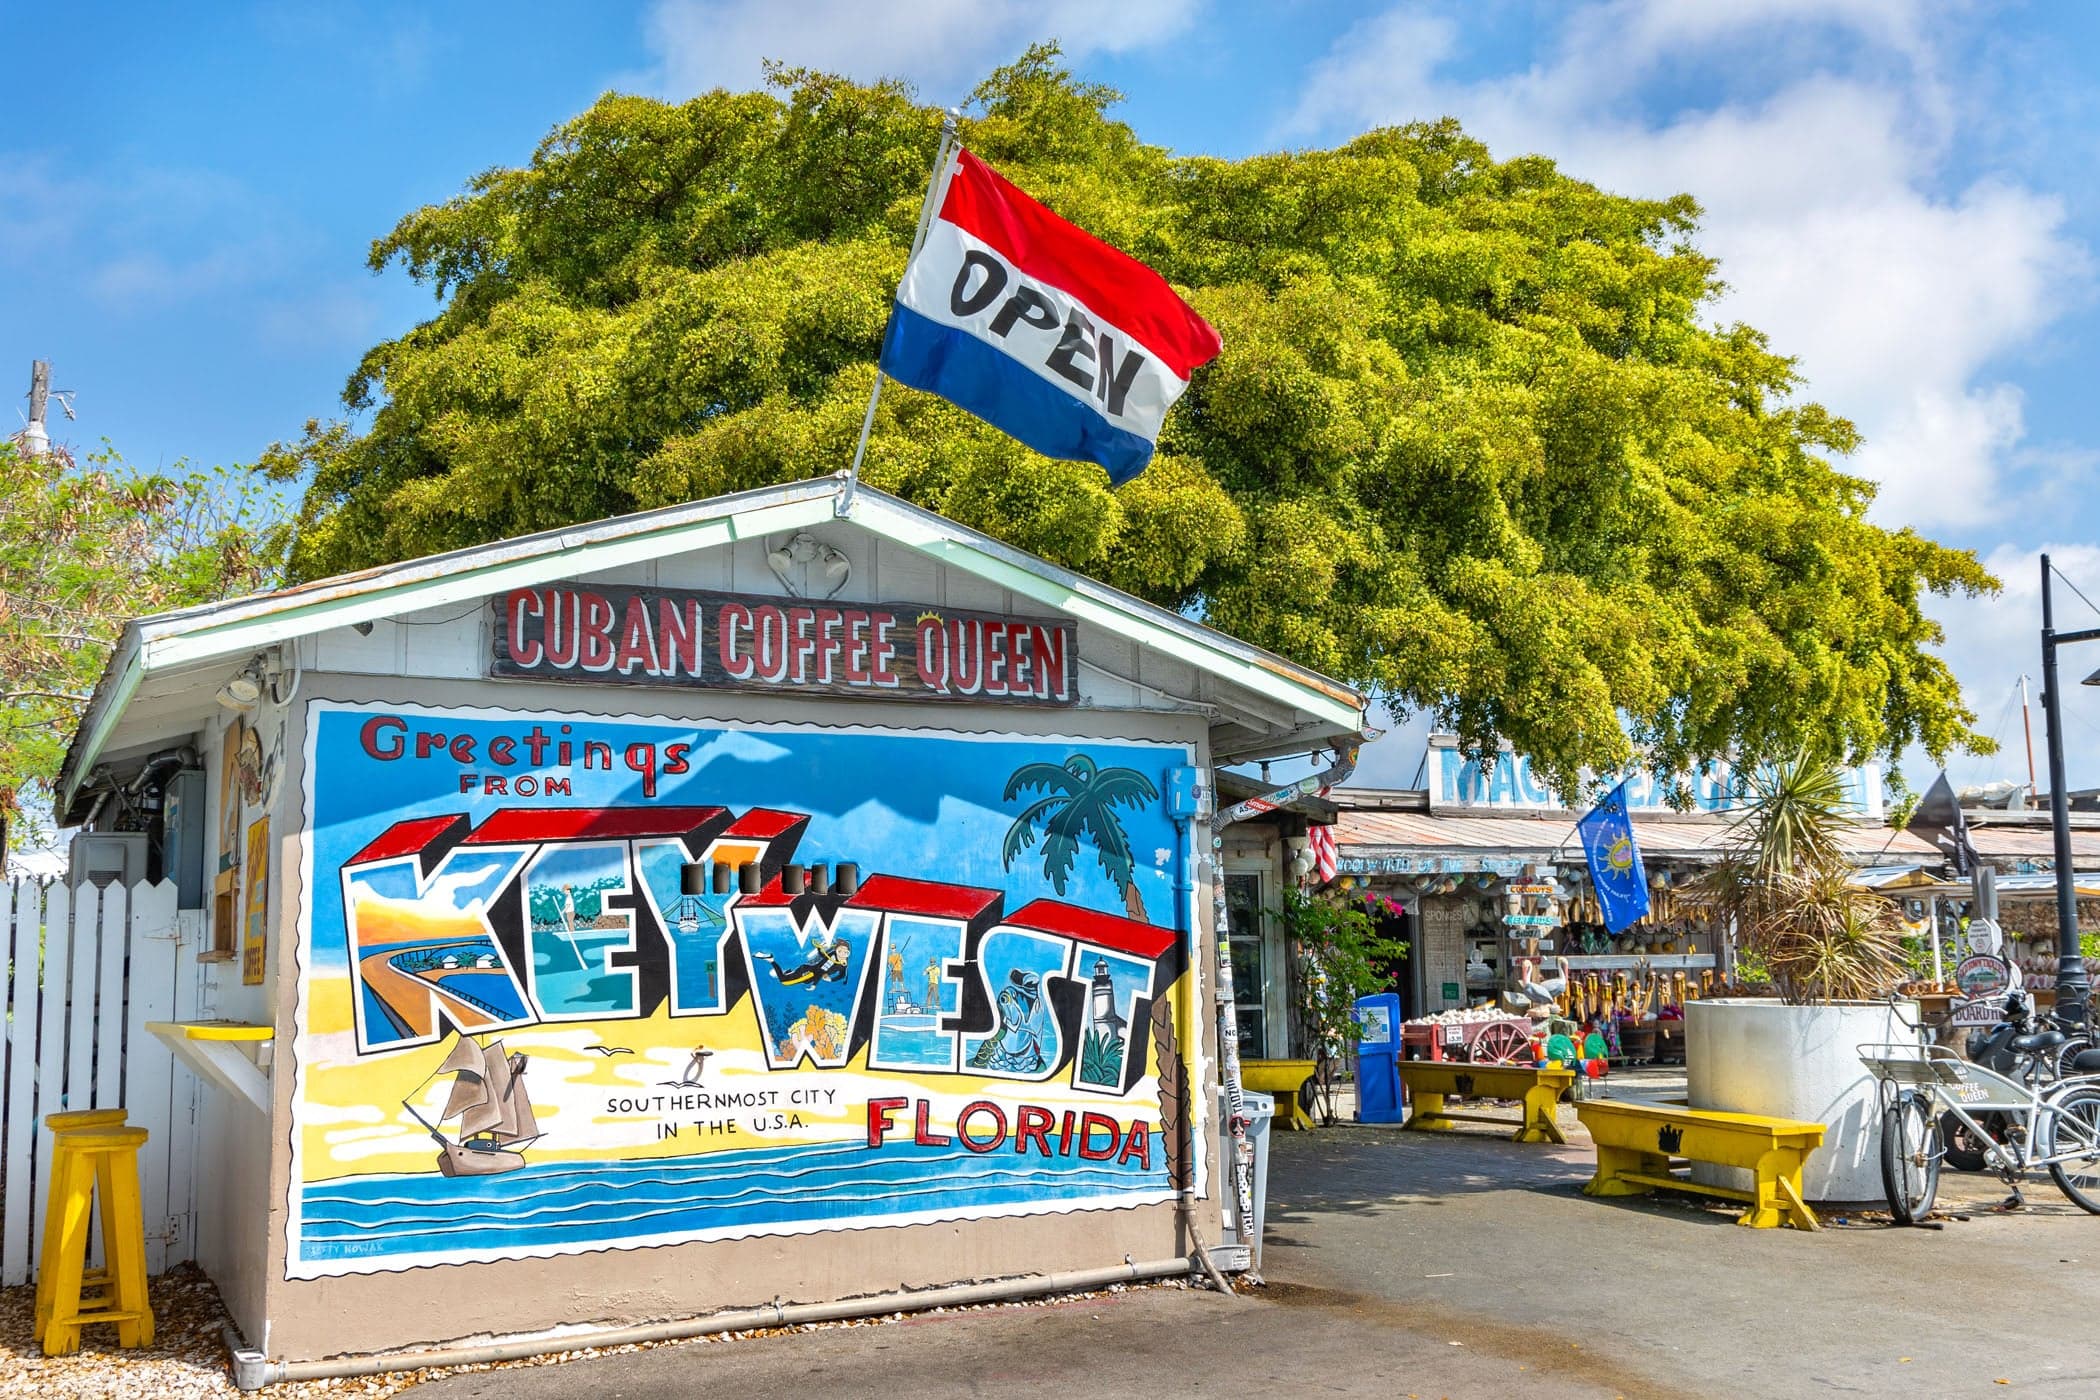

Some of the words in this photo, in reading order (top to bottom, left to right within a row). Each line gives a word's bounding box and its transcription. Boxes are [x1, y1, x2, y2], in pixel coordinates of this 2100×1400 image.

[950, 249, 1145, 417] OPEN
[506, 588, 702, 678] CUBAN
[719, 603, 899, 688] COFFEE
[916, 615, 1069, 701] QUEEN
[460, 774, 572, 797] FROM
[341, 815, 790, 1056] KEY
[735, 880, 1175, 1096] WEST
[607, 1091, 778, 1112] SOUTHERNMOST
[791, 1089, 835, 1105] CITY
[1960, 1089, 1989, 1102] QUEEN
[657, 1122, 677, 1139] IN
[694, 1119, 736, 1136] THE
[753, 1114, 808, 1132] U.S.A.
[868, 1097, 1150, 1170] FLORIDA
[344, 1243, 384, 1254] NOWAK
